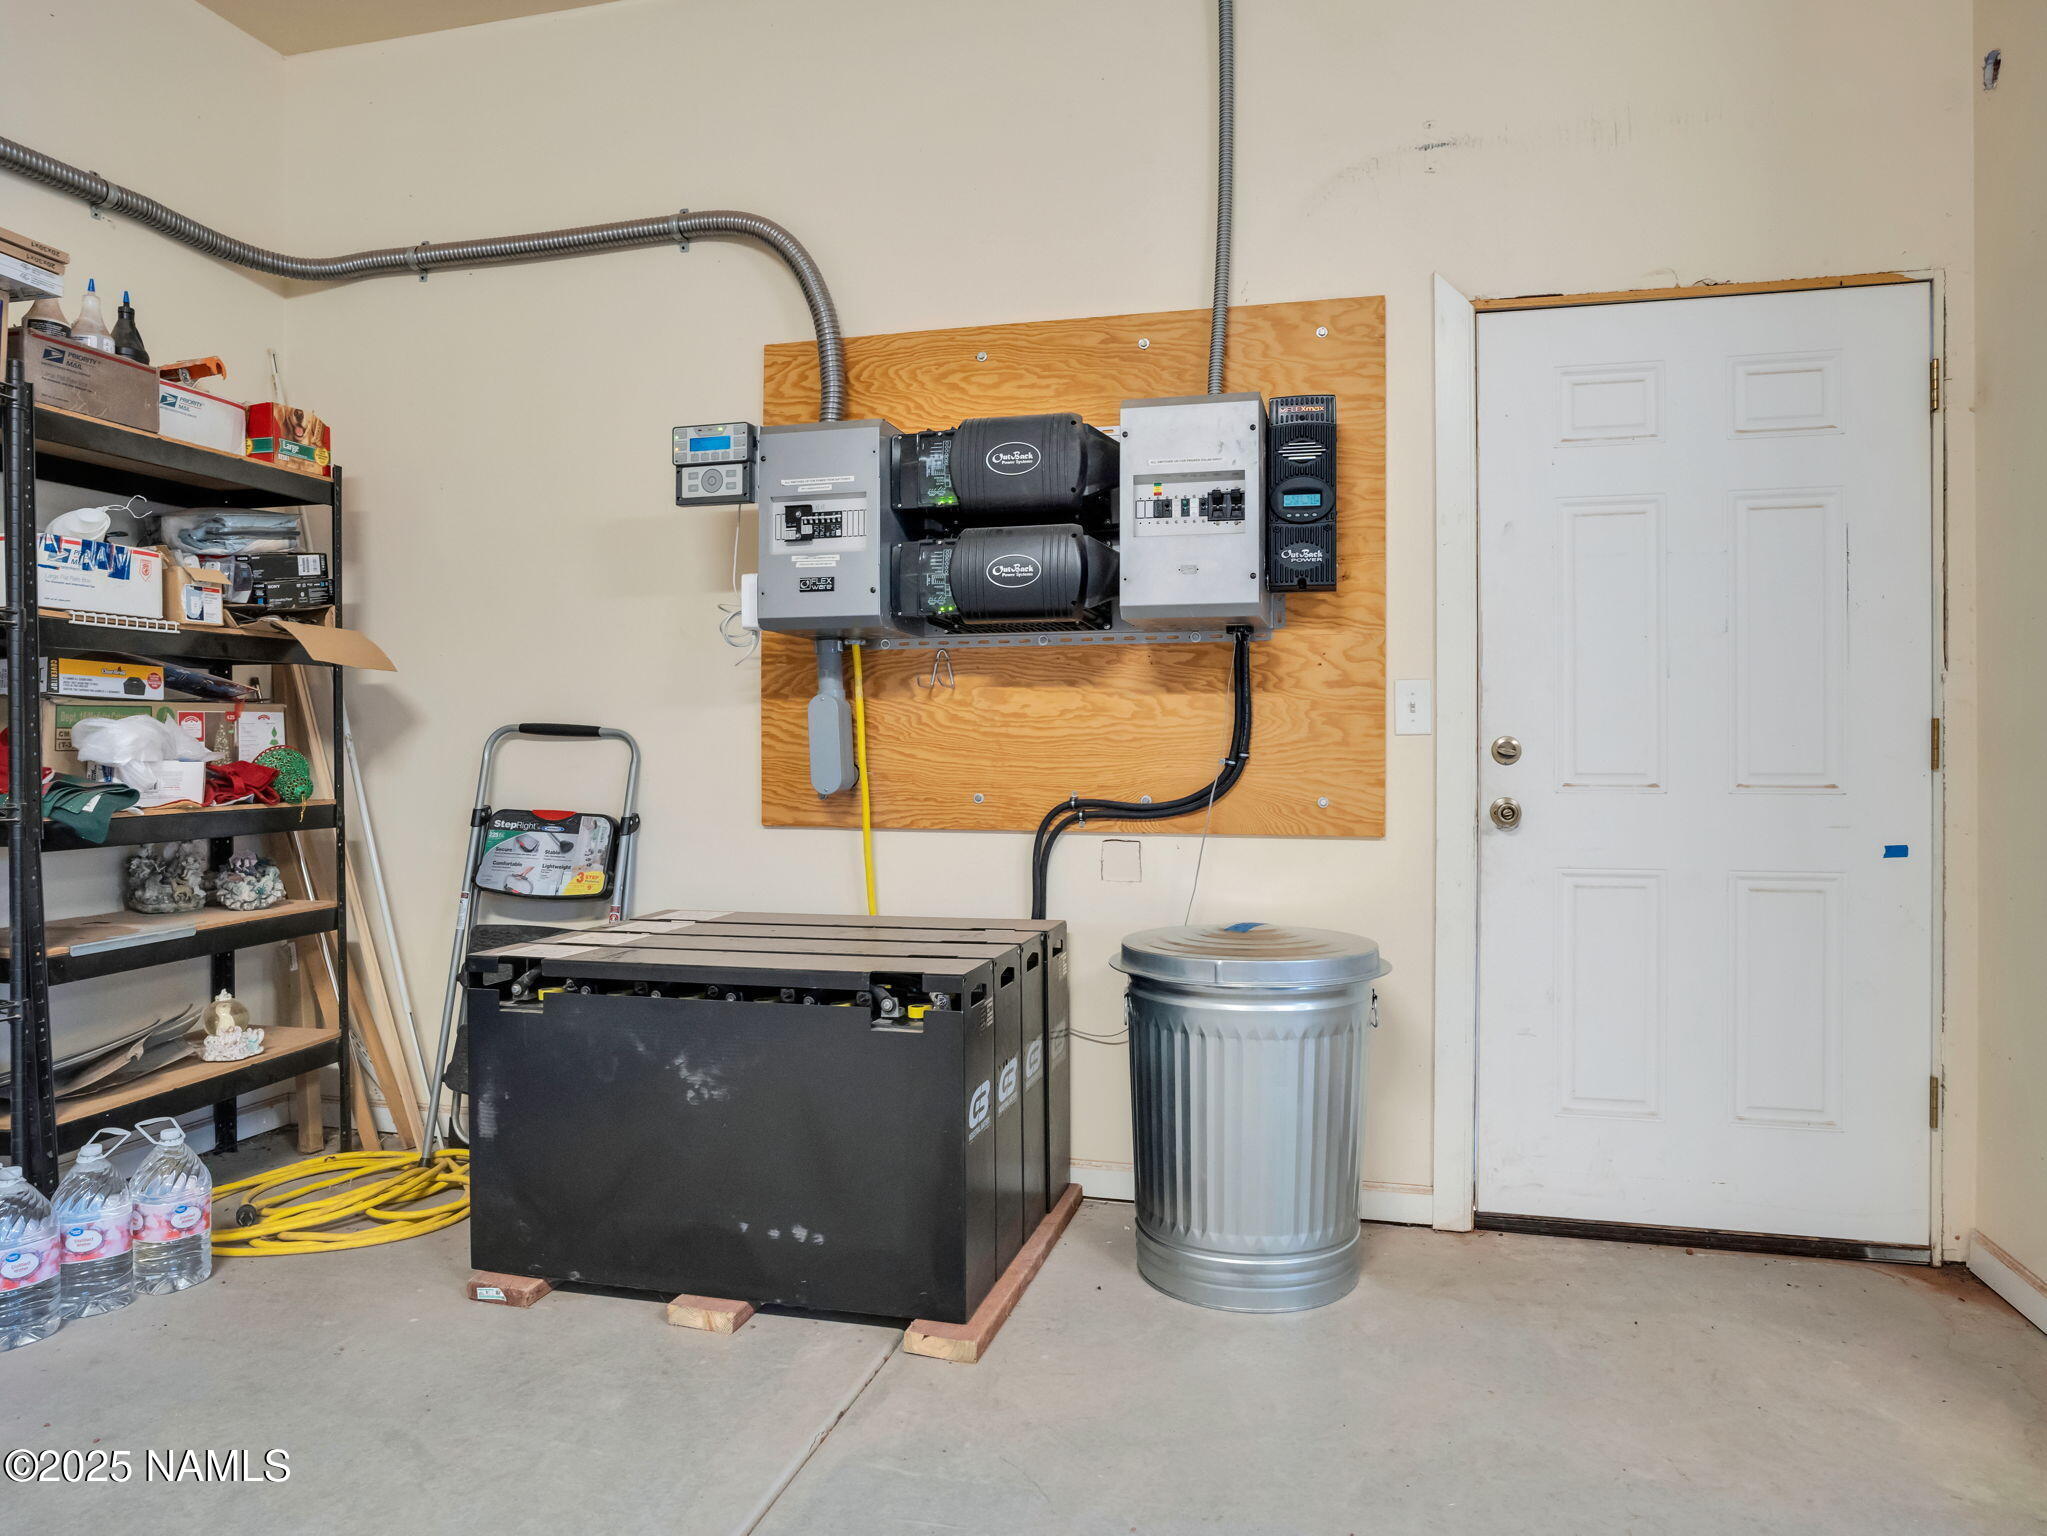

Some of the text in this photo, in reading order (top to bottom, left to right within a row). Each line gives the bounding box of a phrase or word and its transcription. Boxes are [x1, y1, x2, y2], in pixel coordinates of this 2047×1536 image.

[282, 440, 300, 453] Large
[992, 451, 1033, 463] OutBack
[1281, 549, 1323, 559] OutBack
[992, 563, 1034, 575] OutBack
[494, 819, 537, 831] StepRight
[576, 871, 585, 883] 3
